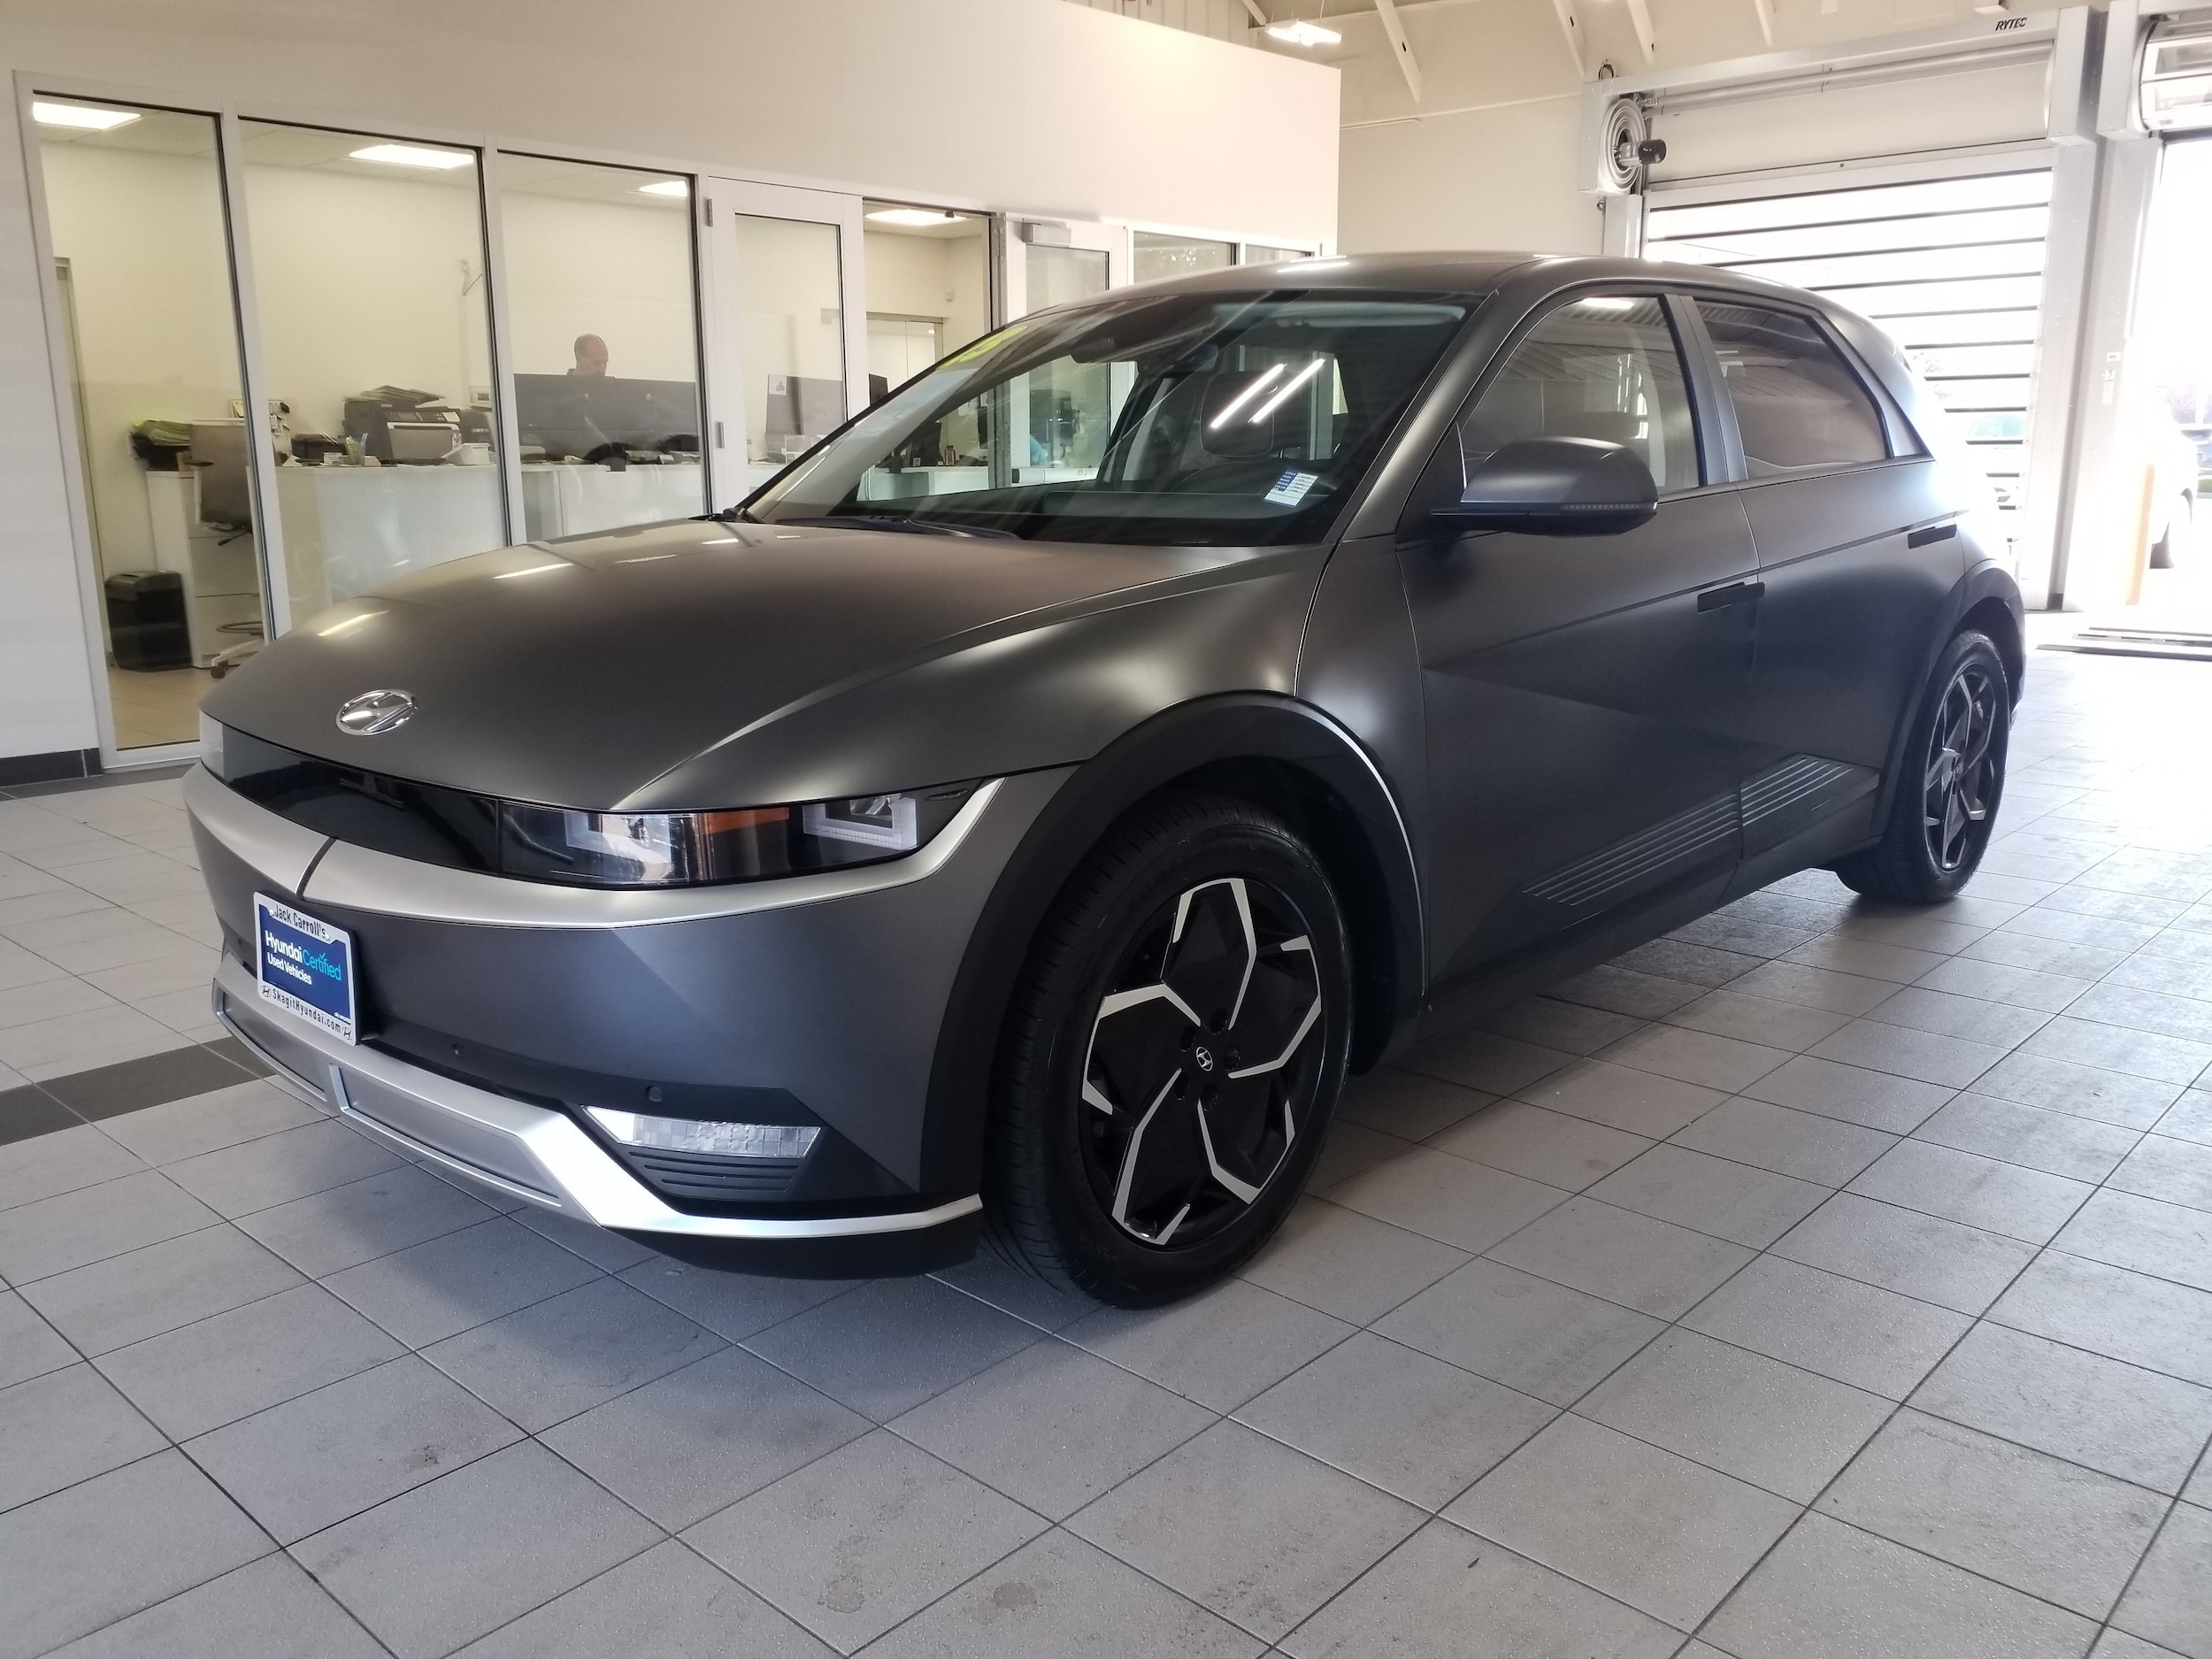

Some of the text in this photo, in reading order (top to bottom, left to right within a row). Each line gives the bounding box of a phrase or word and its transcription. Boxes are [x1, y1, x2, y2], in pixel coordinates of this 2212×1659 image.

[1995, 18, 2027, 31] RYTEC
[274, 904, 326, 939] Jack Carroll's
[265, 930, 342, 981] Hyundai Certified
[267, 952, 312, 986] Used Vehicles
[273, 988, 342, 1033] SkagitHyundai.com
